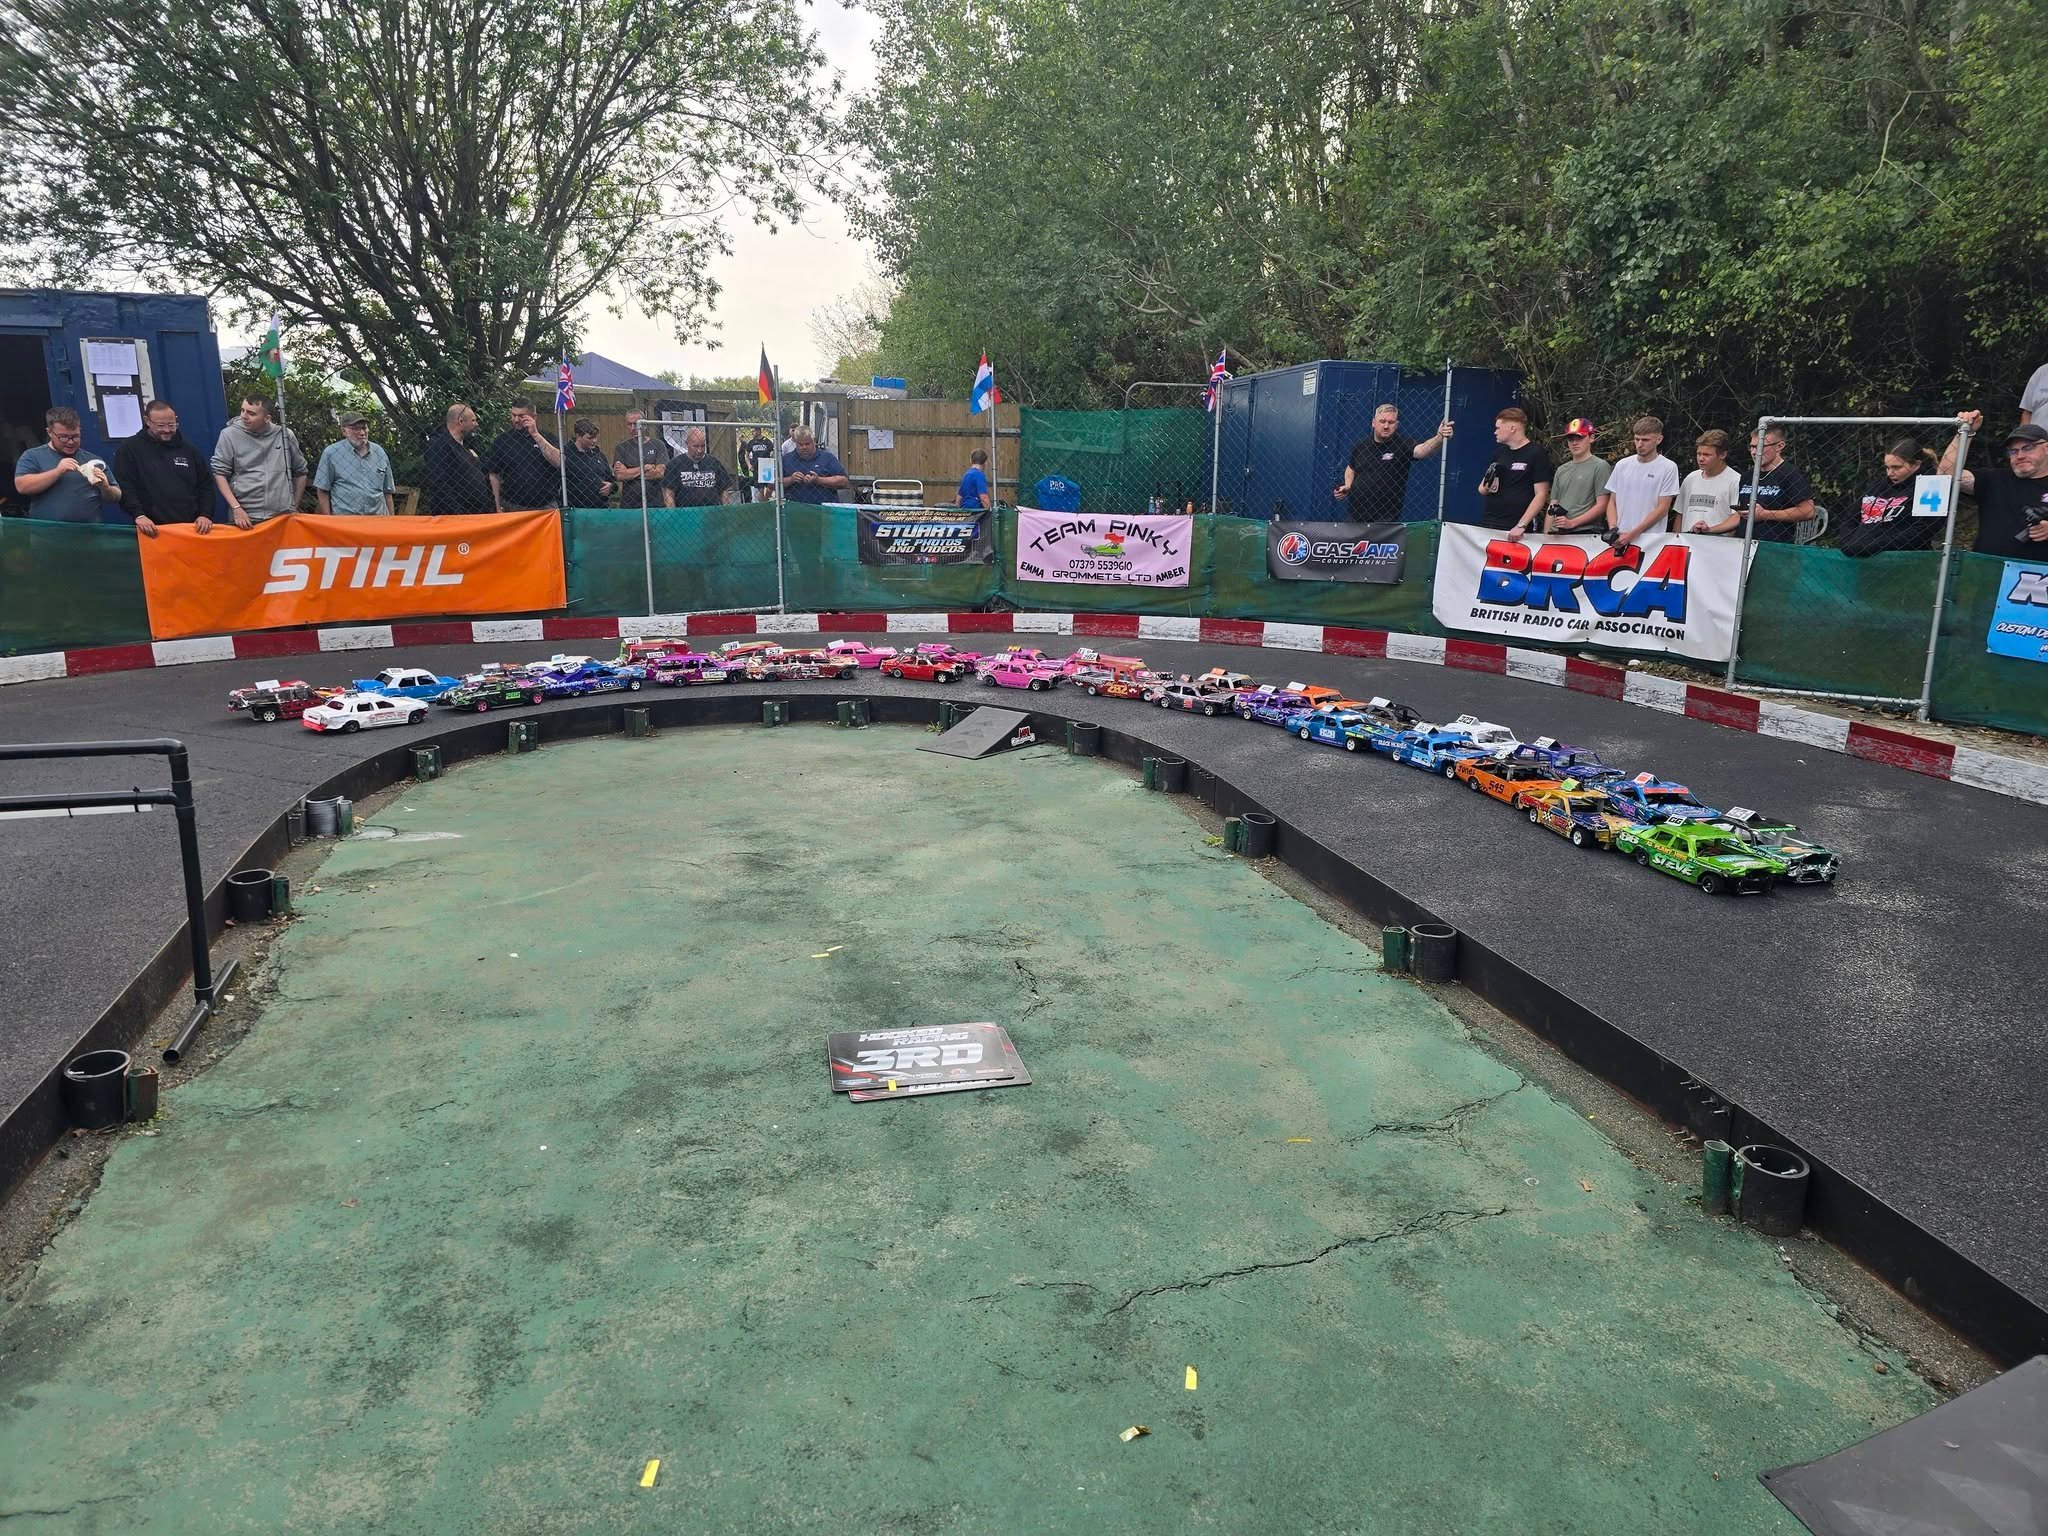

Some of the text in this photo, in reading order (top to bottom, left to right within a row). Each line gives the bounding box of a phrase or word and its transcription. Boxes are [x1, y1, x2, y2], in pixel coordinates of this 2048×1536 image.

[1919, 481, 1942, 512] 4
[892, 538, 962, 546] RC PHOTOS
[1029, 519, 1179, 556] TEAM PINKY
[886, 545, 967, 553] AND VIDEOS
[1311, 540, 1400, 559] GAS4AIR
[1020, 561, 1045, 578] EMMA
[1069, 559, 1133, 571] 07379 5539610
[1052, 570, 1152, 582] GROMMETS LTD
[1156, 566, 1186, 583] AMBER
[1477, 539, 1692, 624] BRCA
[1470, 607, 1685, 641] BRITISH RADIO CAR ASSOCIATION
[1996, 622, 2035, 637] CUSTOM
[1457, 764, 1476, 776] Jones
[1652, 853, 1697, 877] STEVE
[892, 1032, 969, 1046] RACING
[852, 1043, 984, 1073] 3RD
